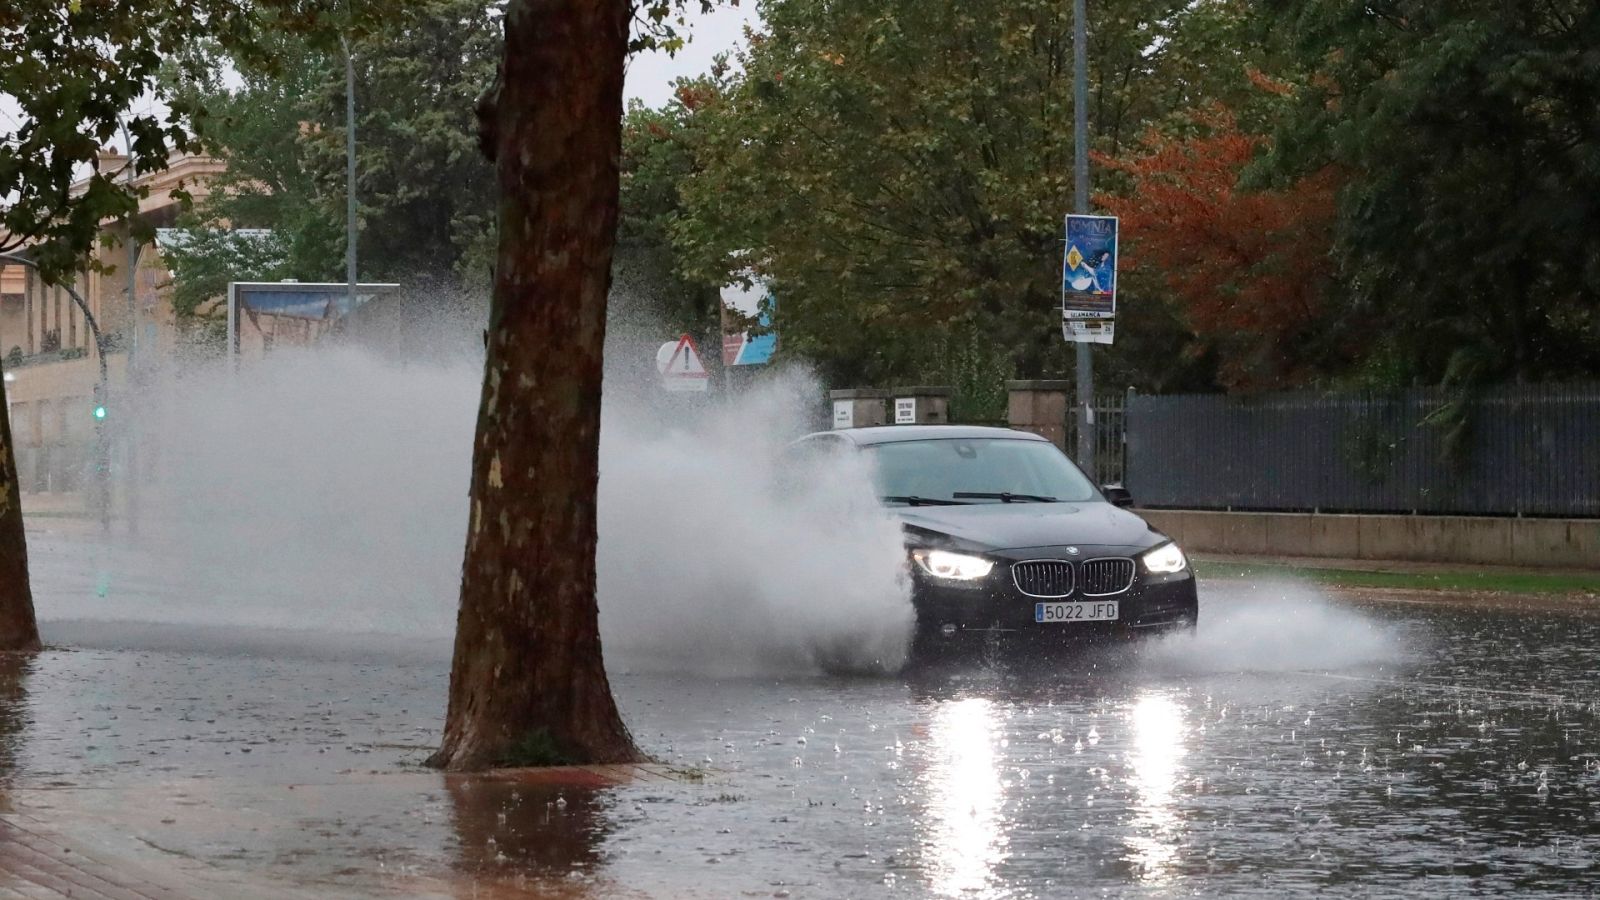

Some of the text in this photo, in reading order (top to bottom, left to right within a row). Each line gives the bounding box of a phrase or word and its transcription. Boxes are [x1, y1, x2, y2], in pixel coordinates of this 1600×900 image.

[1070, 219, 1112, 235] SOMNIA
[1046, 603, 1115, 619] 5022 JFD
